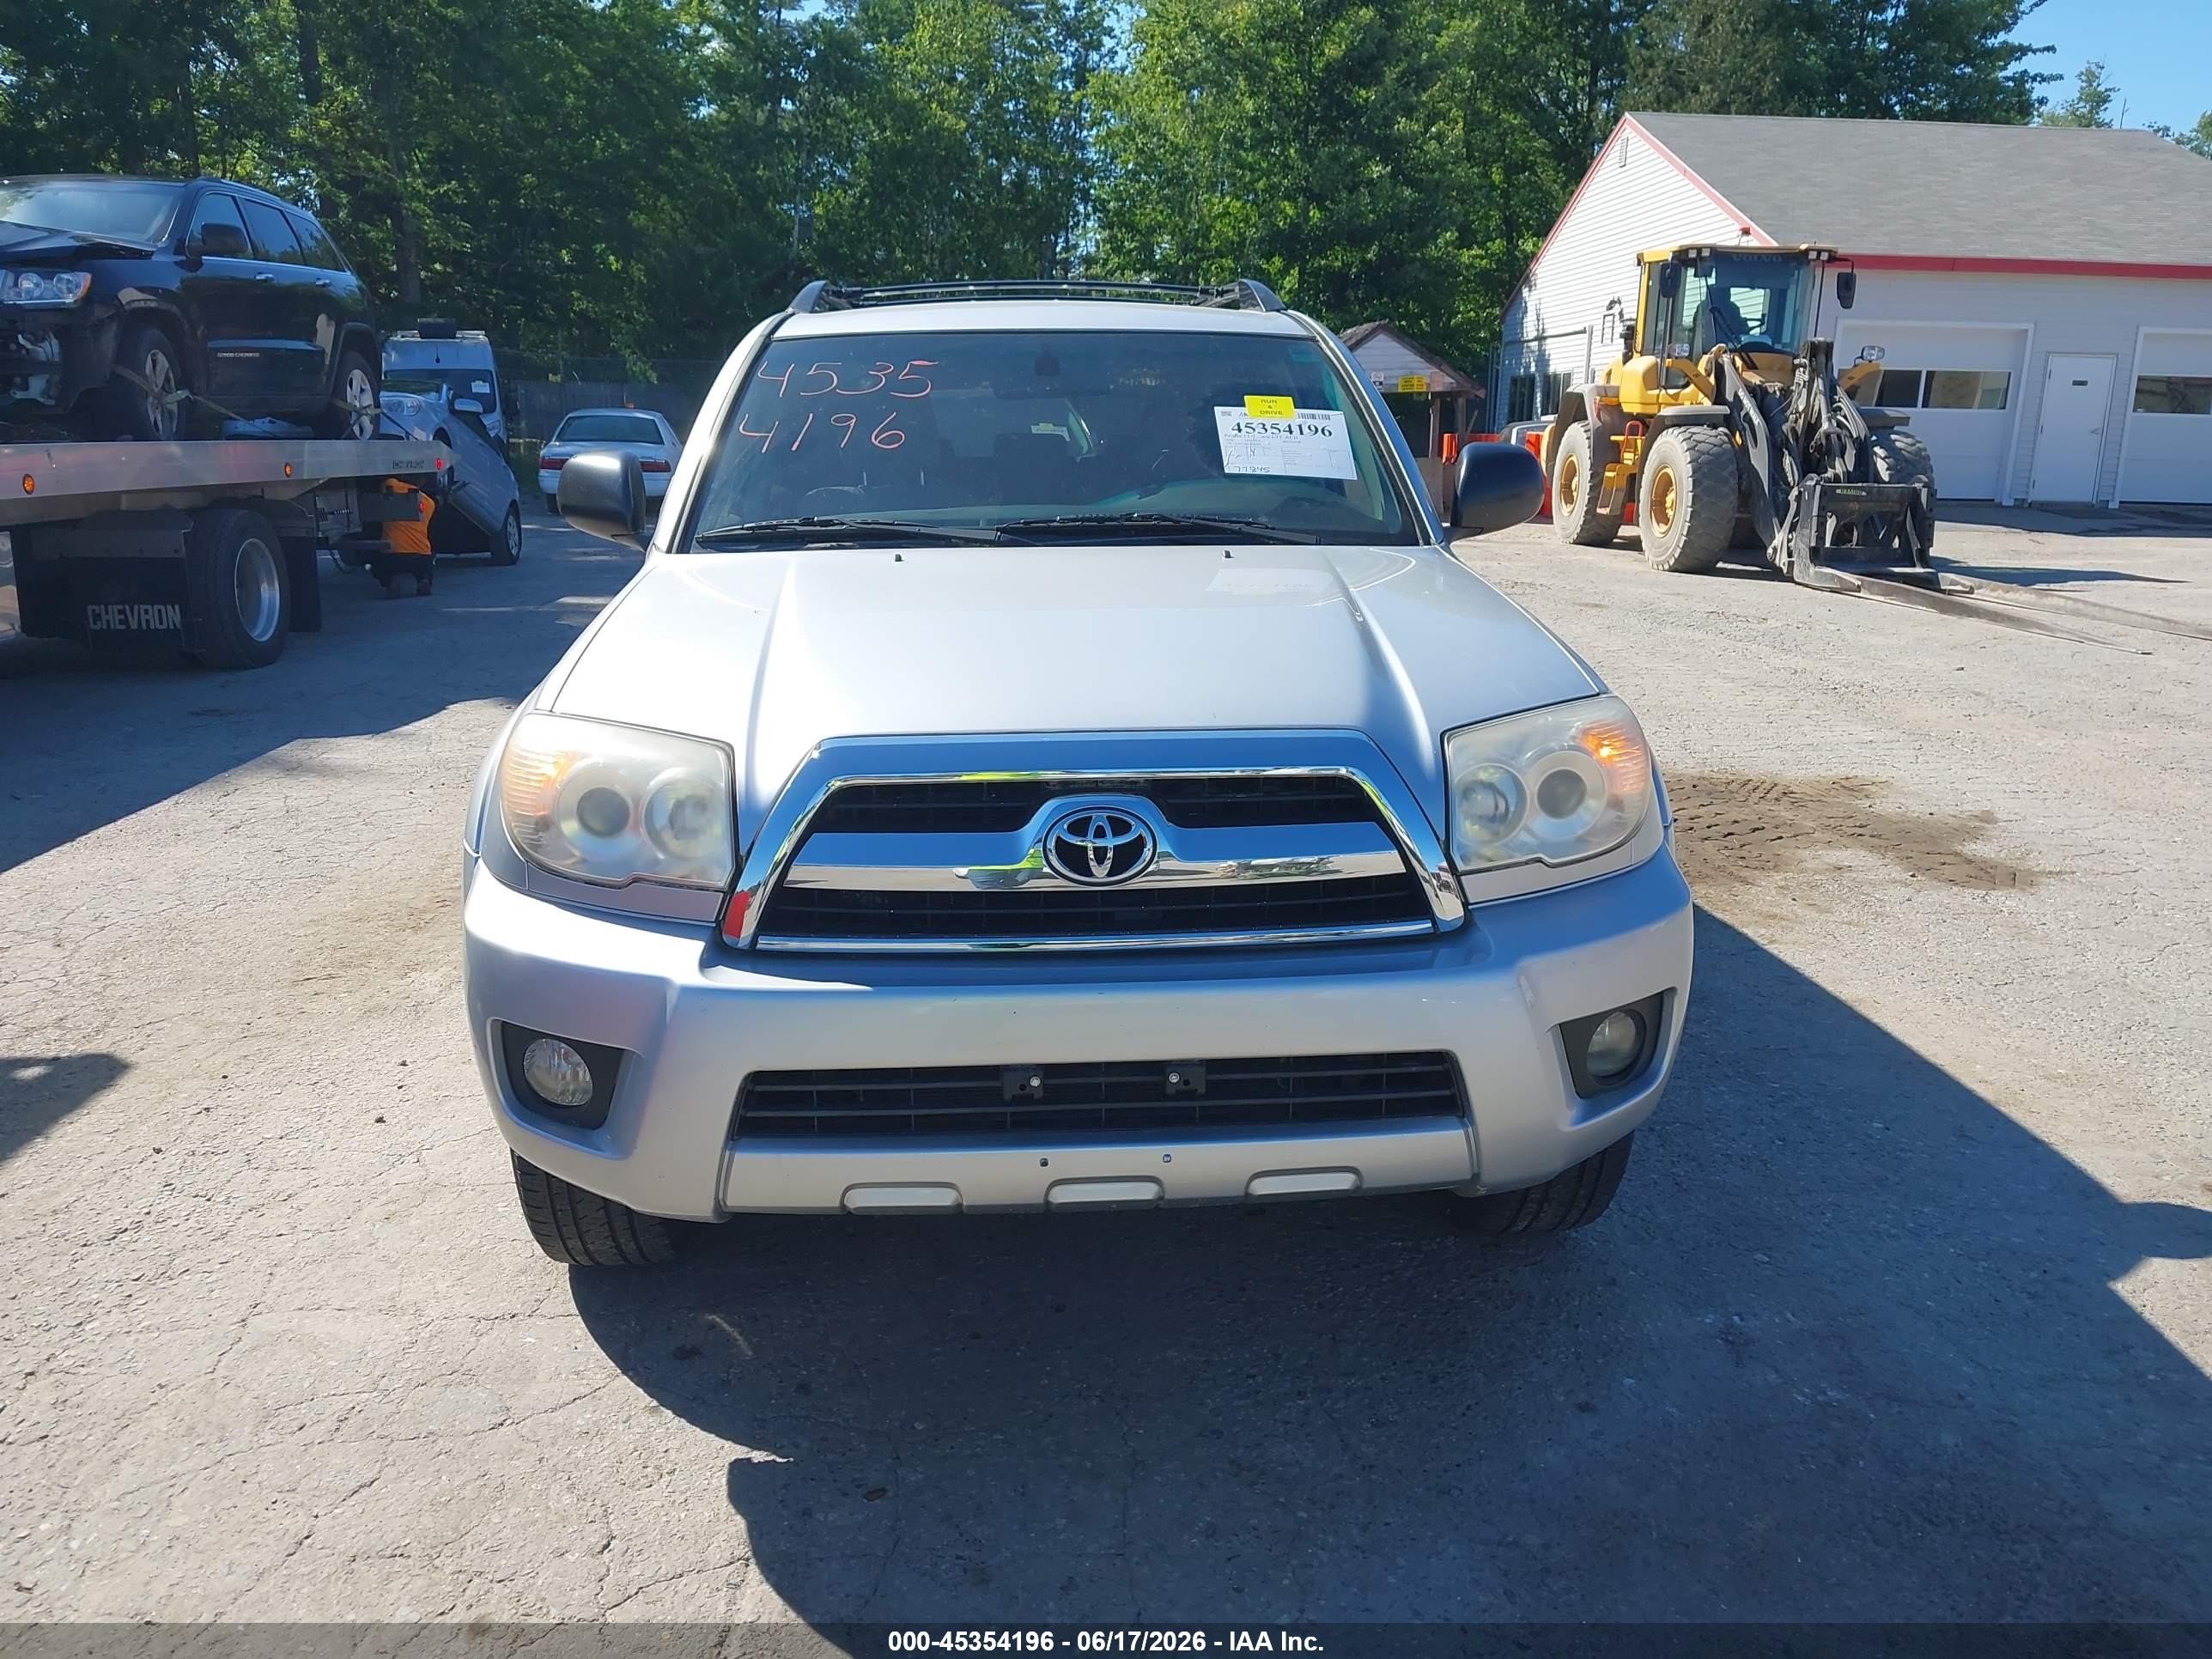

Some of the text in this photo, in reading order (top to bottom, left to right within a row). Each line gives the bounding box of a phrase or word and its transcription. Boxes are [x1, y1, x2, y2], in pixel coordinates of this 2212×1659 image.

[757, 361, 939, 398] 4535
[738, 411, 906, 453] 4196
[1231, 422, 1333, 438] 45354196
[87, 604, 181, 629] CHEVRON
